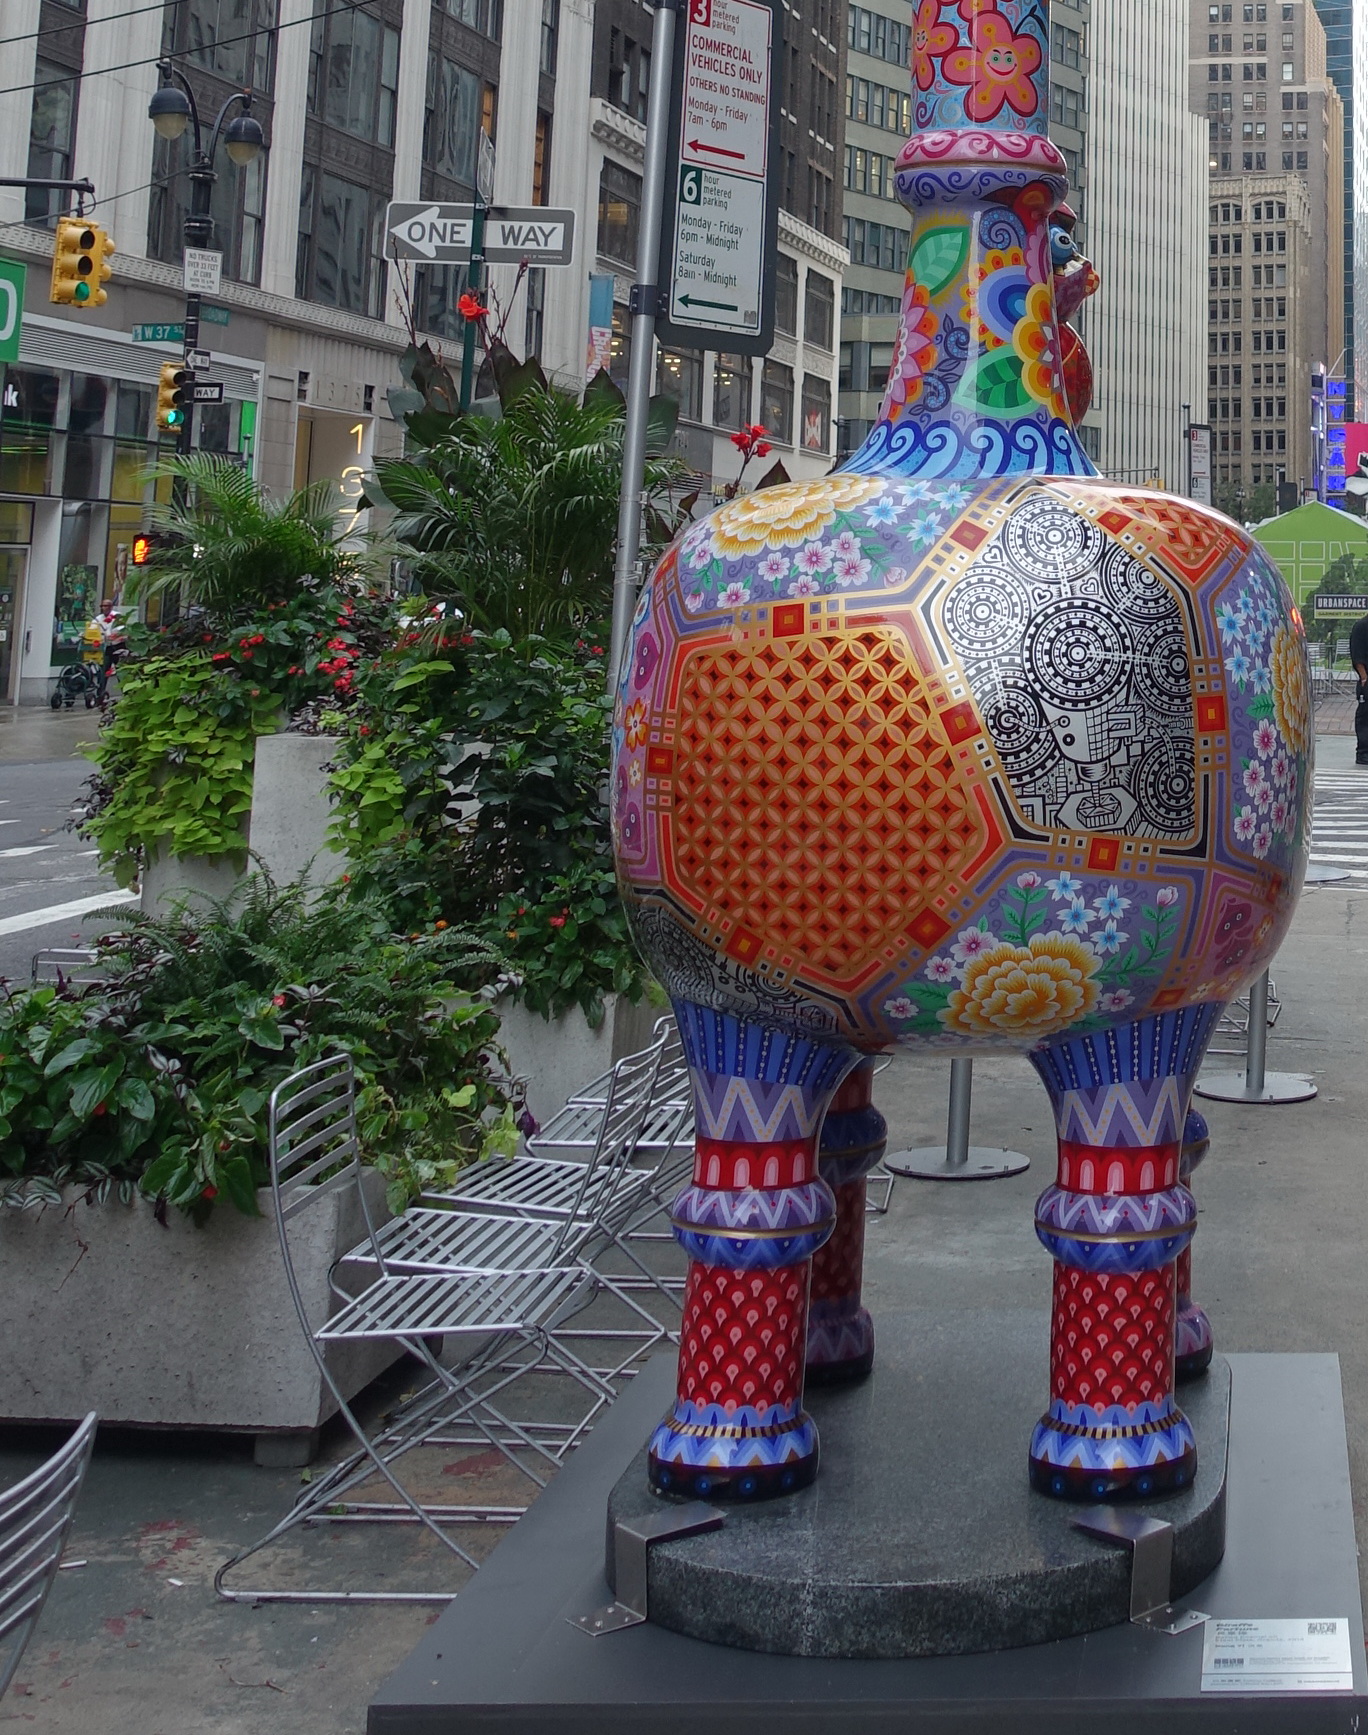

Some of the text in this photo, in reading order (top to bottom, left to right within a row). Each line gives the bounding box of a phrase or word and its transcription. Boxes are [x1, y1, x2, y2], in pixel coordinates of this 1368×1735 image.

[713, 9, 740, 24] metered
[712, 20, 736, 36] parking
[691, 34, 753, 64] COMMERCIAL
[691, 52, 763, 84] VEHICLES ONLY
[690, 76, 766, 105] OTHERS NO STANDING
[688, 96, 718, 116] Monday
[725, 106, 748, 124] Friday
[688, 111, 704, 126] 7am
[711, 117, 727, 131] 6pm
[683, 170, 698, 202] 6
[704, 173, 720, 185] hour
[703, 185, 732, 199] metered
[702, 196, 728, 210] parking
[407, 221, 558, 247] ONE WAY
[681, 213, 712, 232] Monday
[720, 221, 743, 238] Friday
[680, 229, 698, 243] 6pm
[706, 233, 739, 251] Midnight
[680, 250, 715, 270] Saturday
[704, 270, 737, 287] Midnight
[144, 326, 154, 339] W
[156, 326, 170, 339] 37
[195, 388, 216, 397] WAY
[1317, 597, 1367, 608] URBANSPACE
